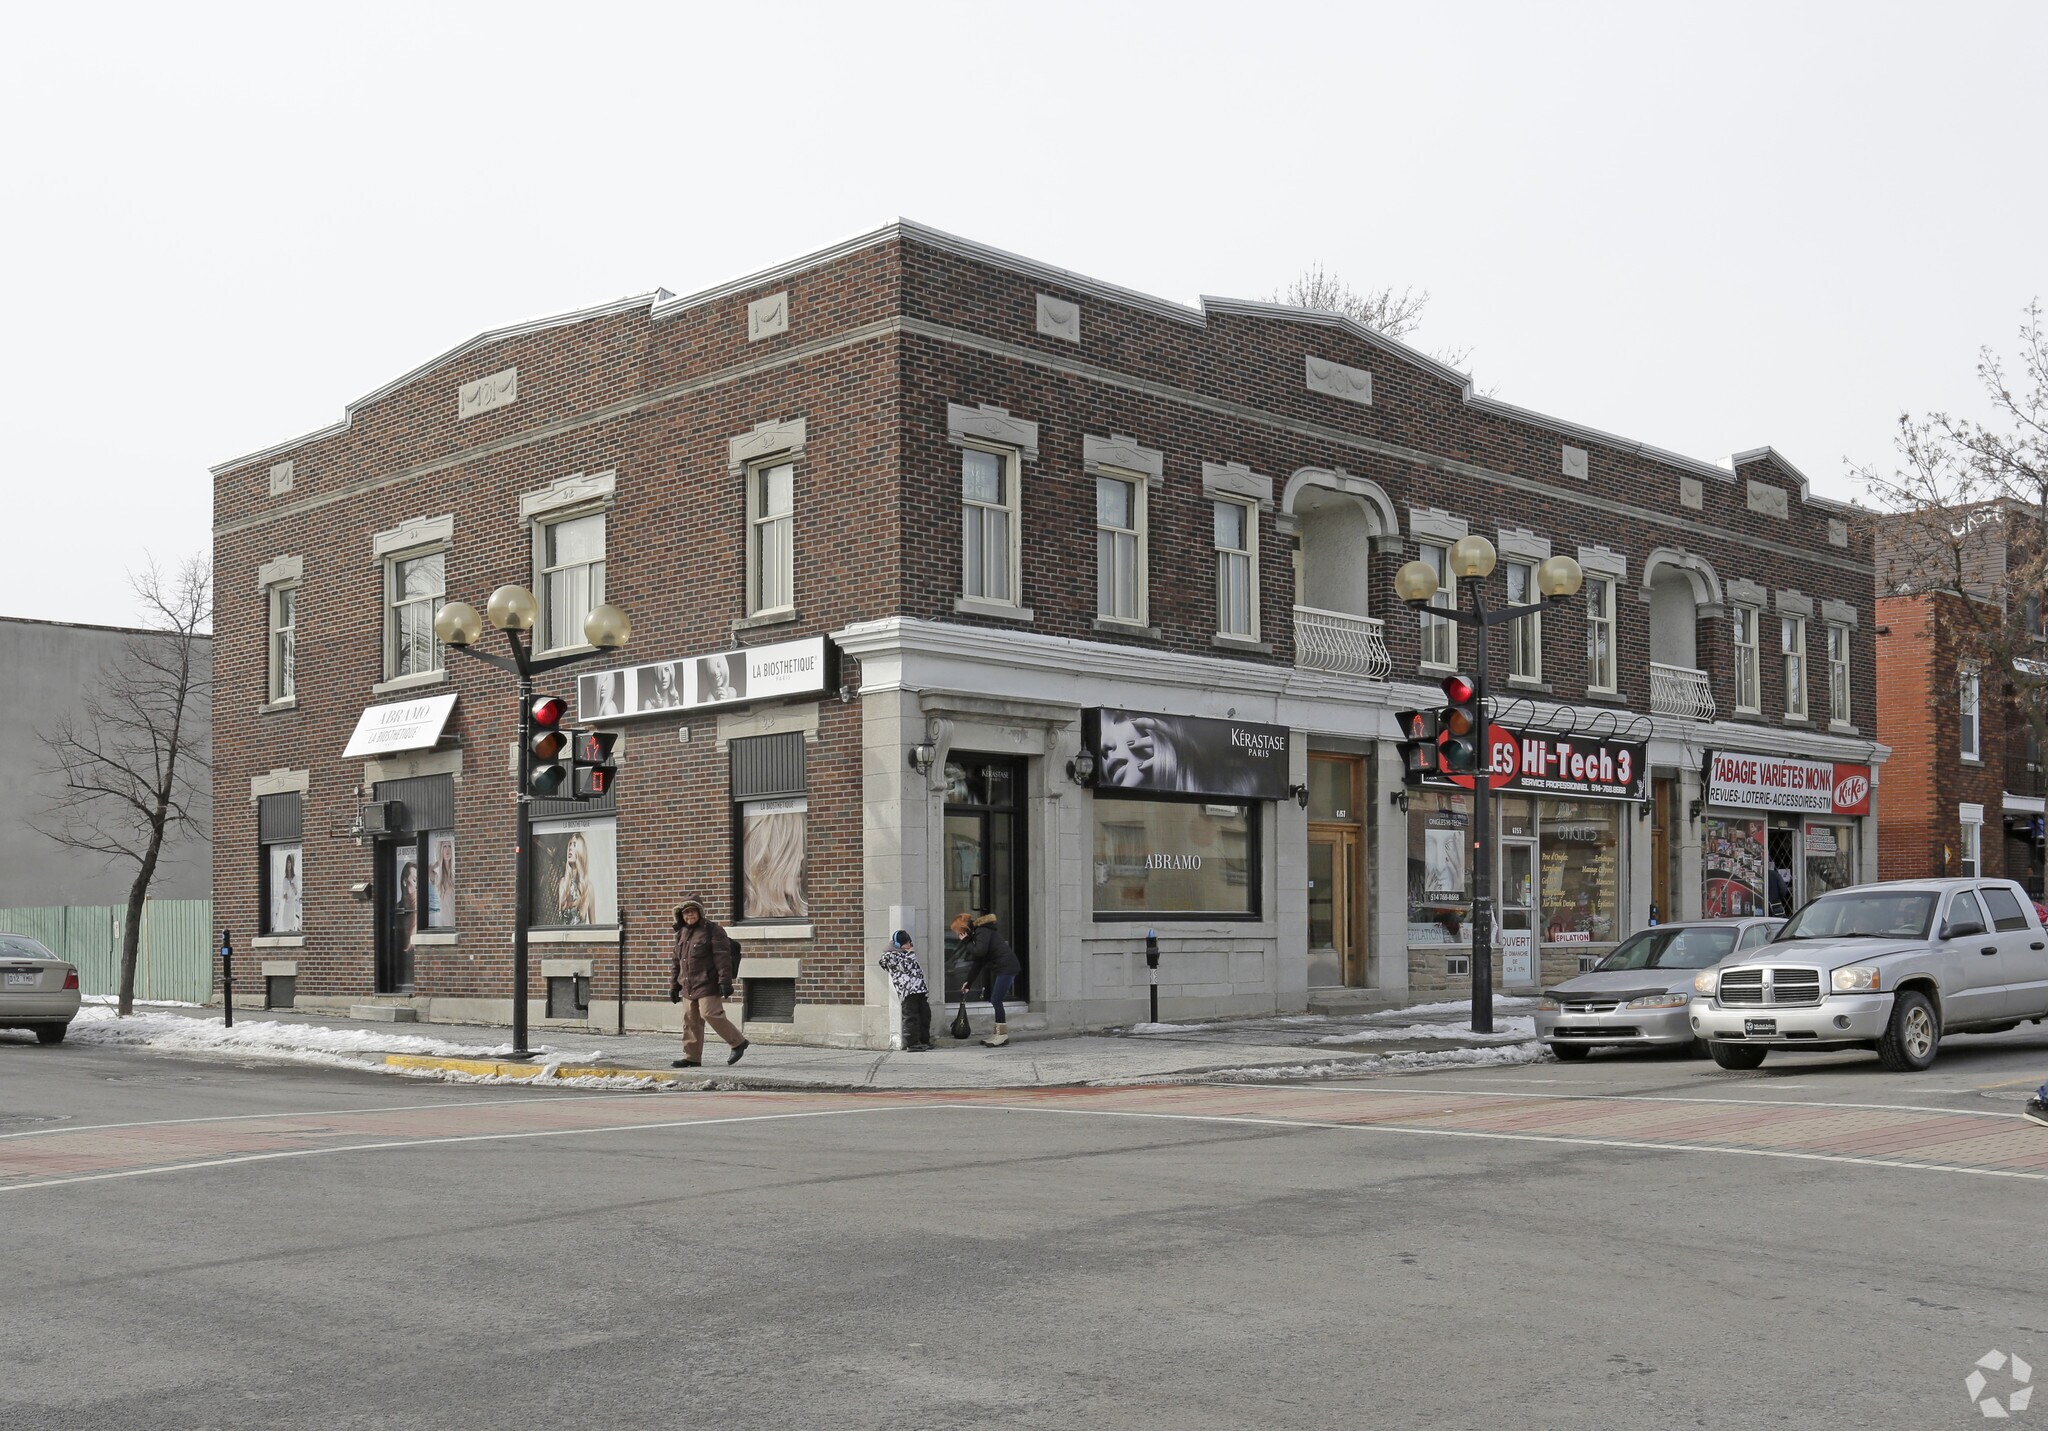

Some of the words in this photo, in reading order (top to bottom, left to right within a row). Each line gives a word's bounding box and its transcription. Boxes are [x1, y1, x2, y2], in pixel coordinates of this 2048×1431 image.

[753, 665, 761, 678] LA
[377, 705, 430, 725] ABRAMO
[1231, 727, 1285, 751] KÉRASTASE
[1248, 748, 1270, 758] PARIS
[1522, 738, 1613, 781] Hi-Tech
[1617, 749, 1631, 783] 3
[1713, 757, 1757, 785] TABAGIE
[1805, 767, 1832, 792] MONK
[1521, 778, 1545, 787] SERVICE
[1545, 780, 1589, 791] PROFESSIONNEL
[1558, 825, 1597, 841] ONGLES
[1144, 854, 1202, 870] ABRAMO
[1555, 933, 1589, 942] EPILATION
